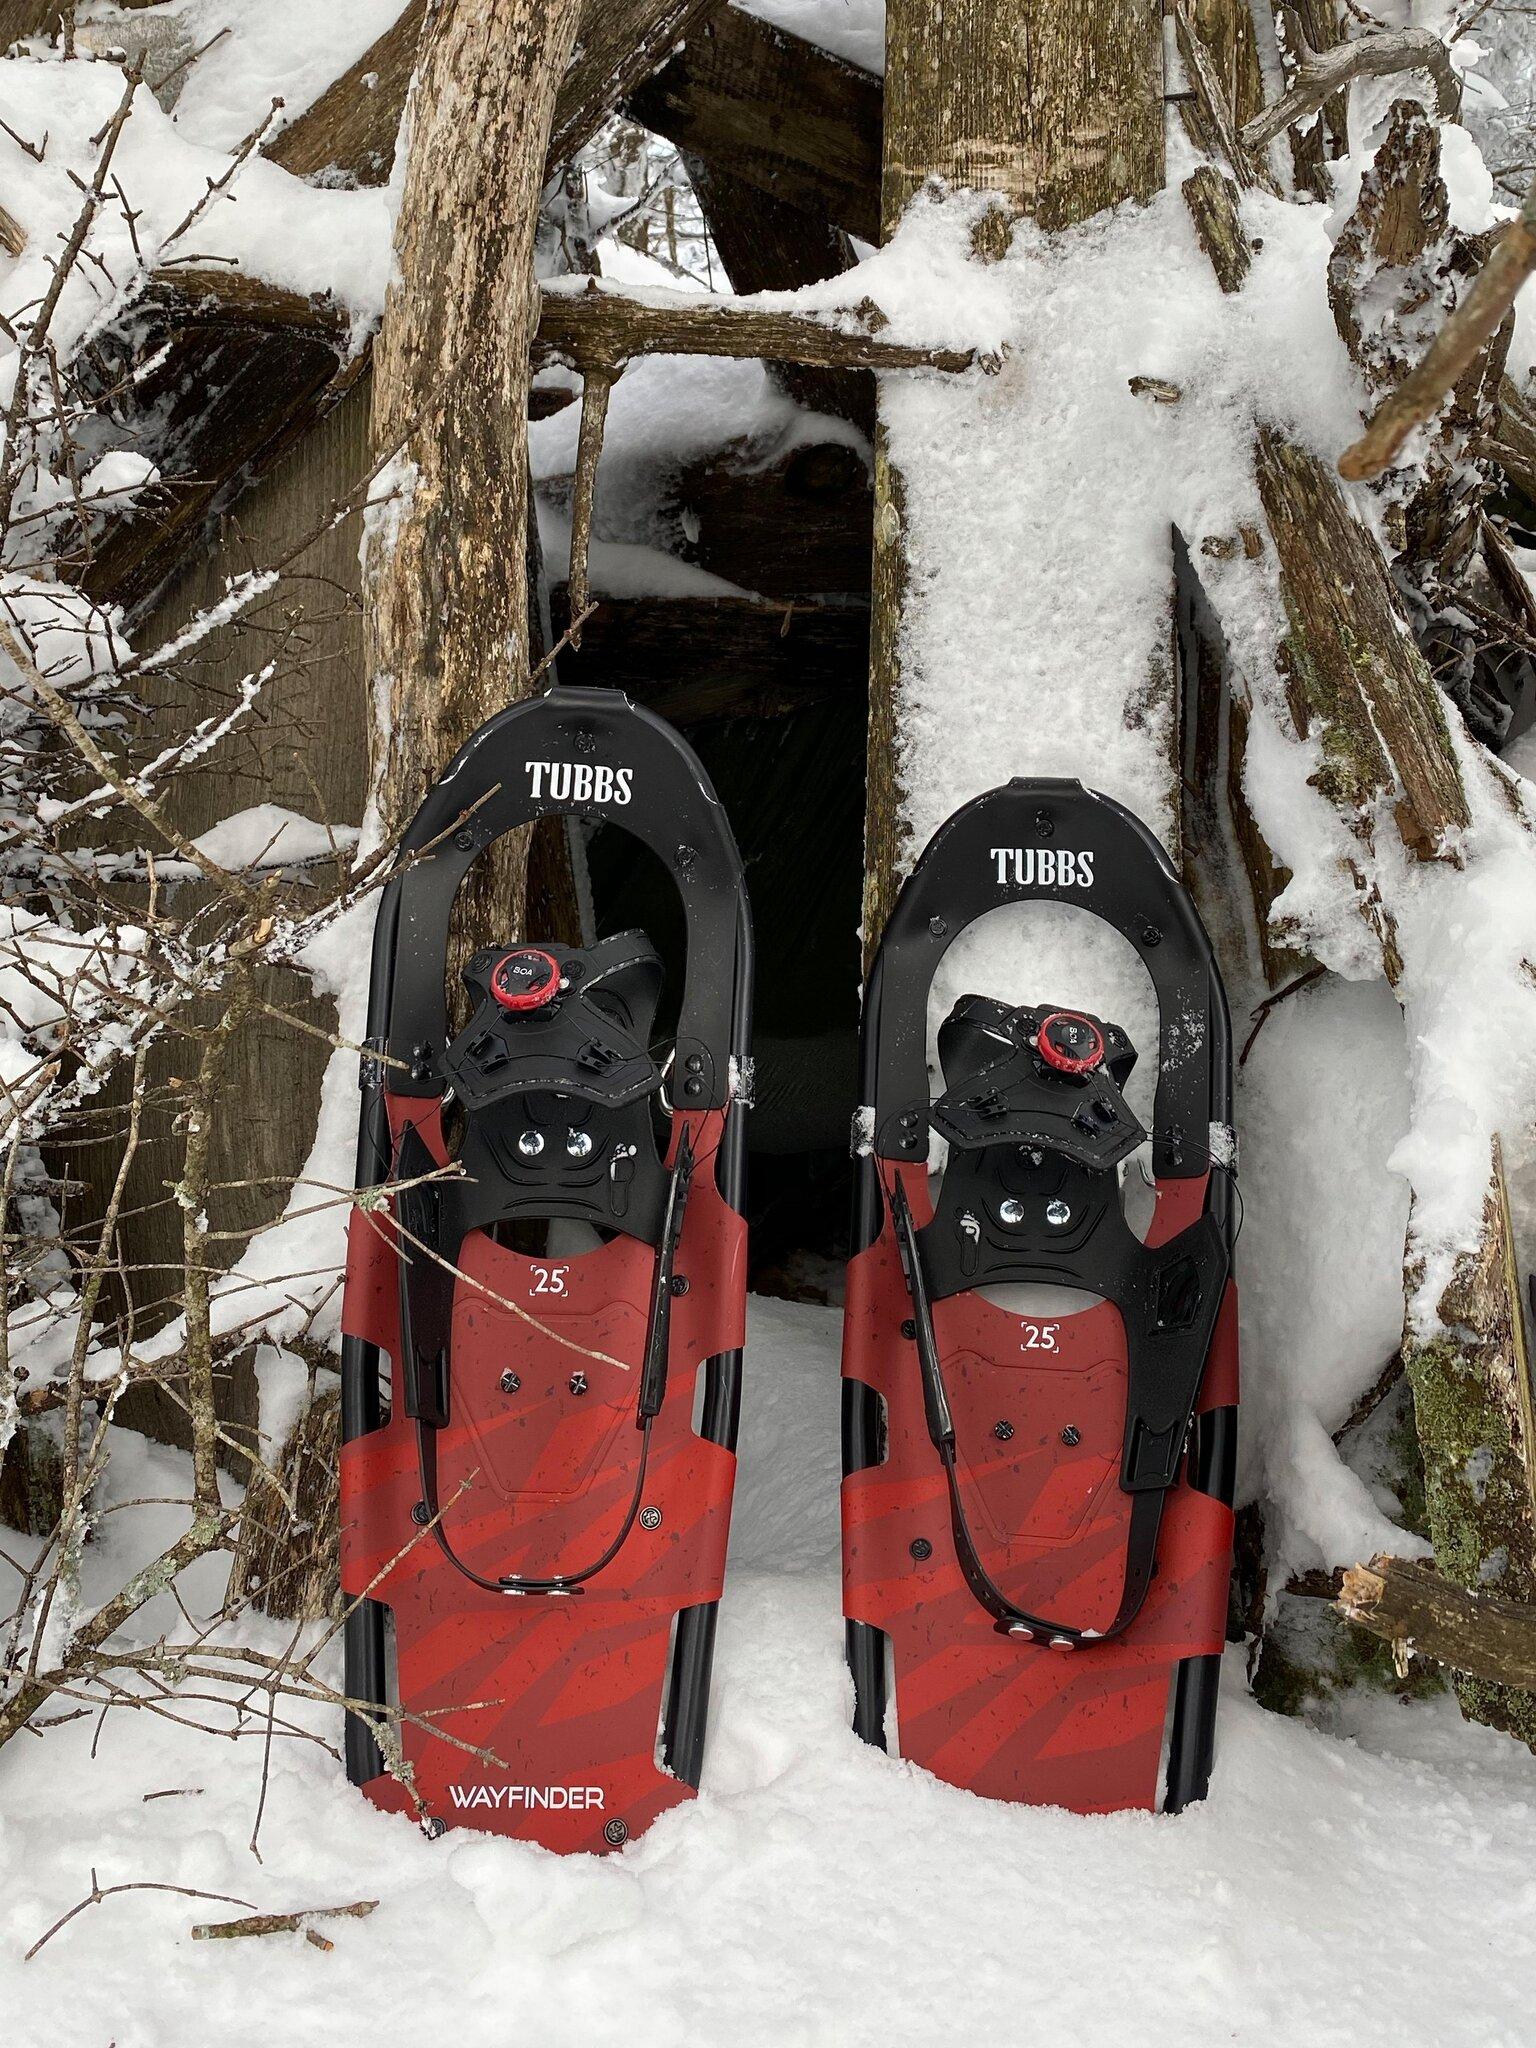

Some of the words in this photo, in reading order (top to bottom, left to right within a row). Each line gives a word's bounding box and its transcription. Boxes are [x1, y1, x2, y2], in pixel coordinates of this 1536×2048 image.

[525, 761, 634, 805] TUBBS
[990, 848, 1095, 887] TUBBS
[512, 966, 533, 976] BOA
[532, 1267, 566, 1294] 25
[1024, 1325, 1057, 1350] 25
[449, 1785, 606, 1810] WAYFINDER
